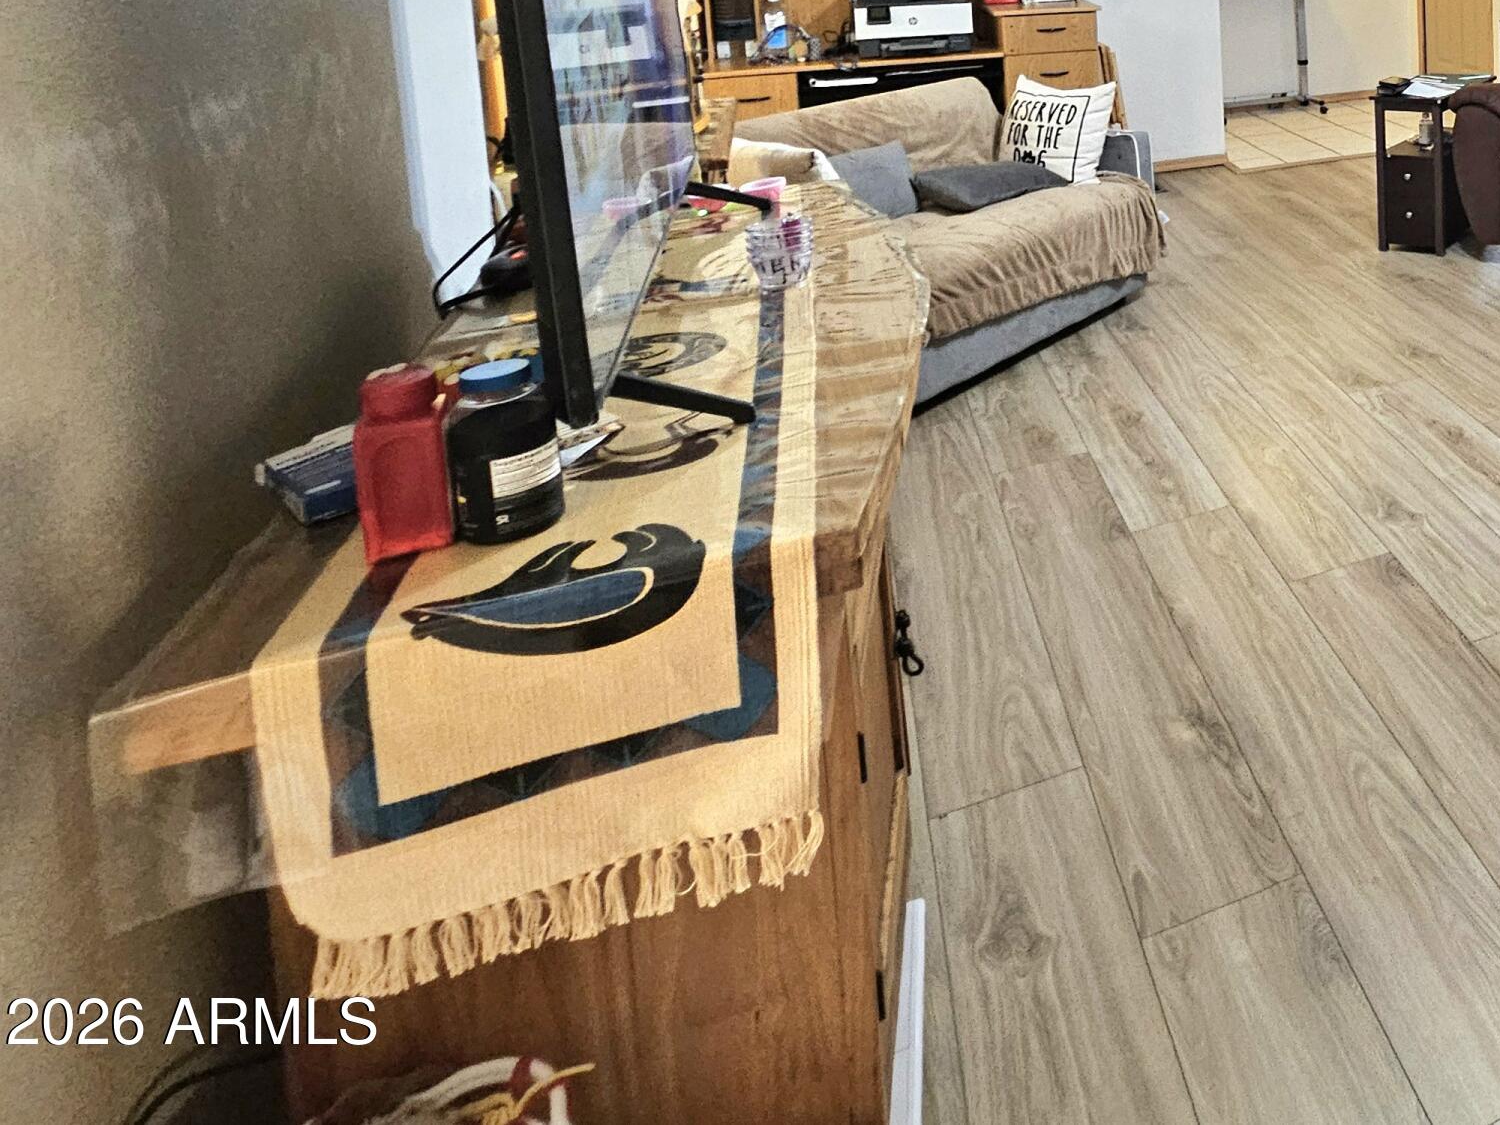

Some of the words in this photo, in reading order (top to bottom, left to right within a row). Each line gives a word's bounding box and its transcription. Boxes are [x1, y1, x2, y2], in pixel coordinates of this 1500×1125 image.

[1009, 99, 1077, 125] RESERVED
[1007, 122, 1029, 146] FOR
[1036, 124, 1063, 149] THE
